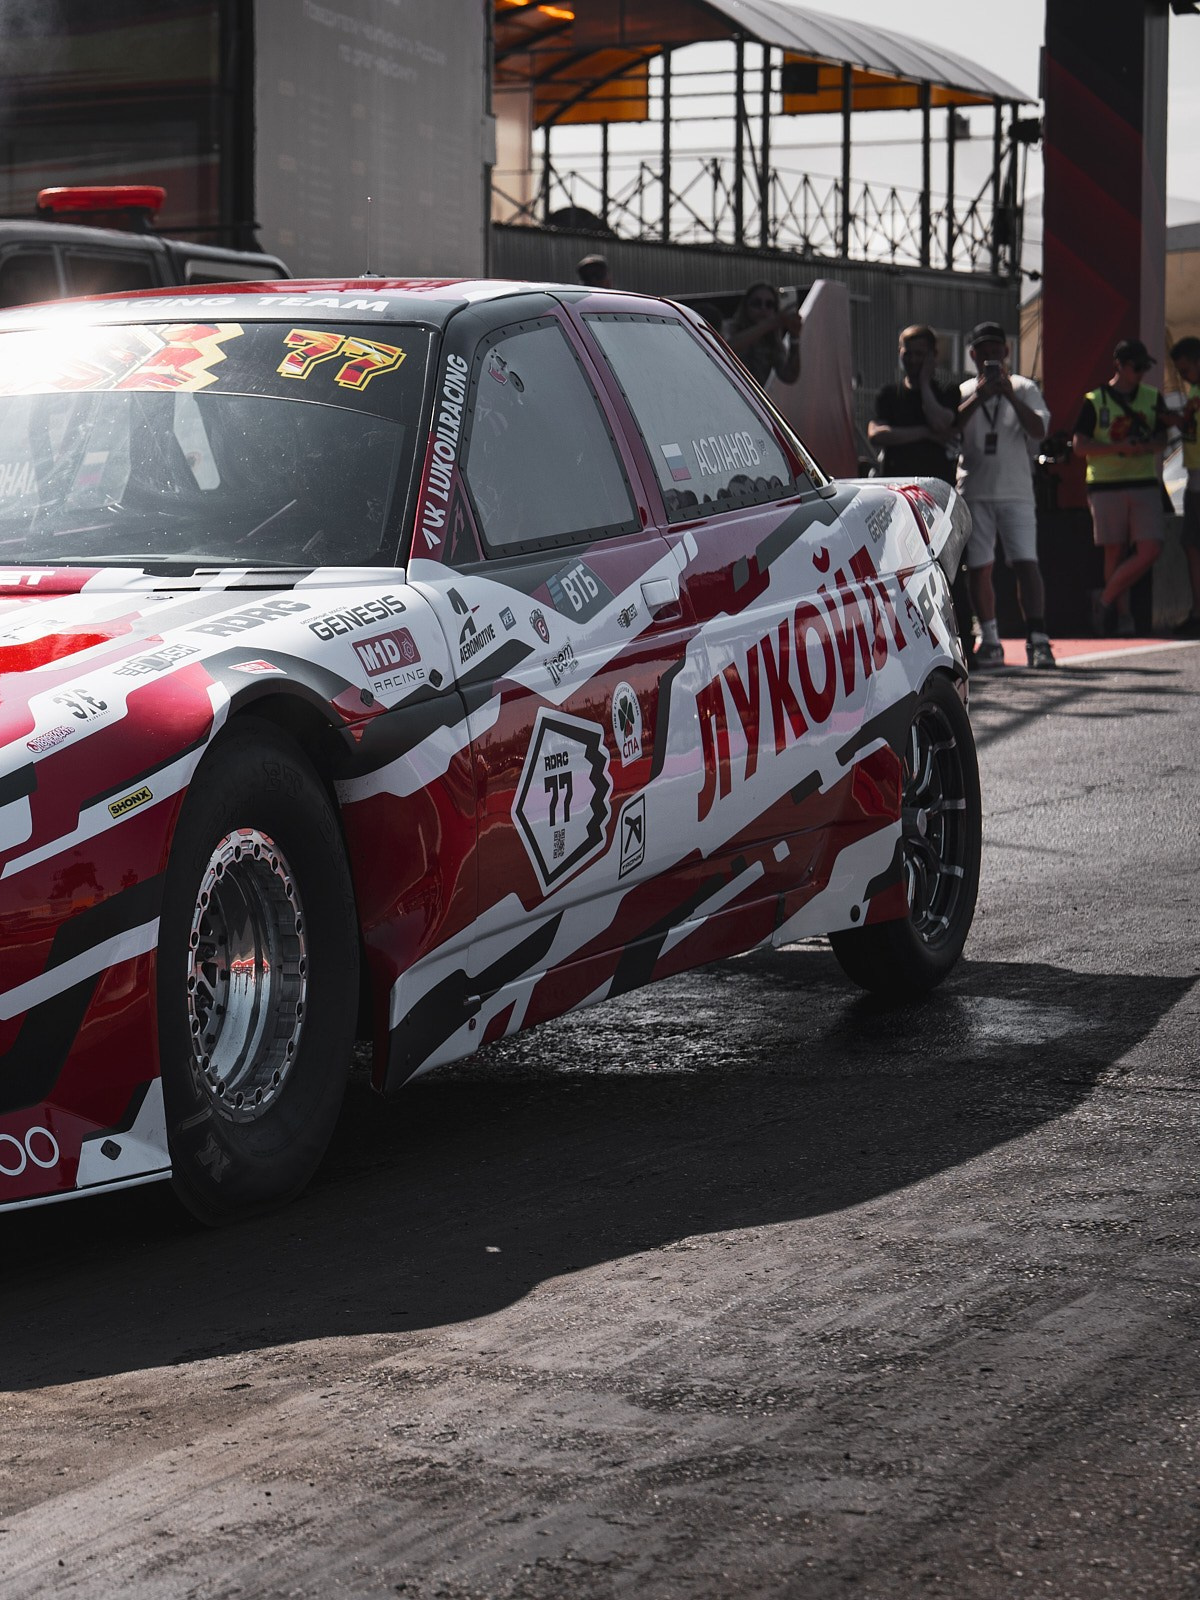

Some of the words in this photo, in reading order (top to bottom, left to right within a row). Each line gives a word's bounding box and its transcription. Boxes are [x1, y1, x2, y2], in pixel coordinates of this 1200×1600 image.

[252, 296, 390, 313] TEAM
[277, 328, 406, 391] 77
[428, 354, 469, 502] LUKOILRACING
[692, 431, 761, 477] АСЛАНОВ
[561, 564, 599, 612] ВТБ
[185, 600, 312, 638] RDRC
[309, 595, 407, 641] GENESIS
[356, 637, 401, 671] M1D
[459, 623, 496, 666] AEROMOTIVE
[374, 668, 425, 693] RACING
[695, 545, 907, 822] ЛУКОЙЛ
[544, 750, 569, 772] RDRC
[623, 736, 640, 759] СПА
[111, 789, 151, 814] SHONX
[544, 771, 574, 827] 77
